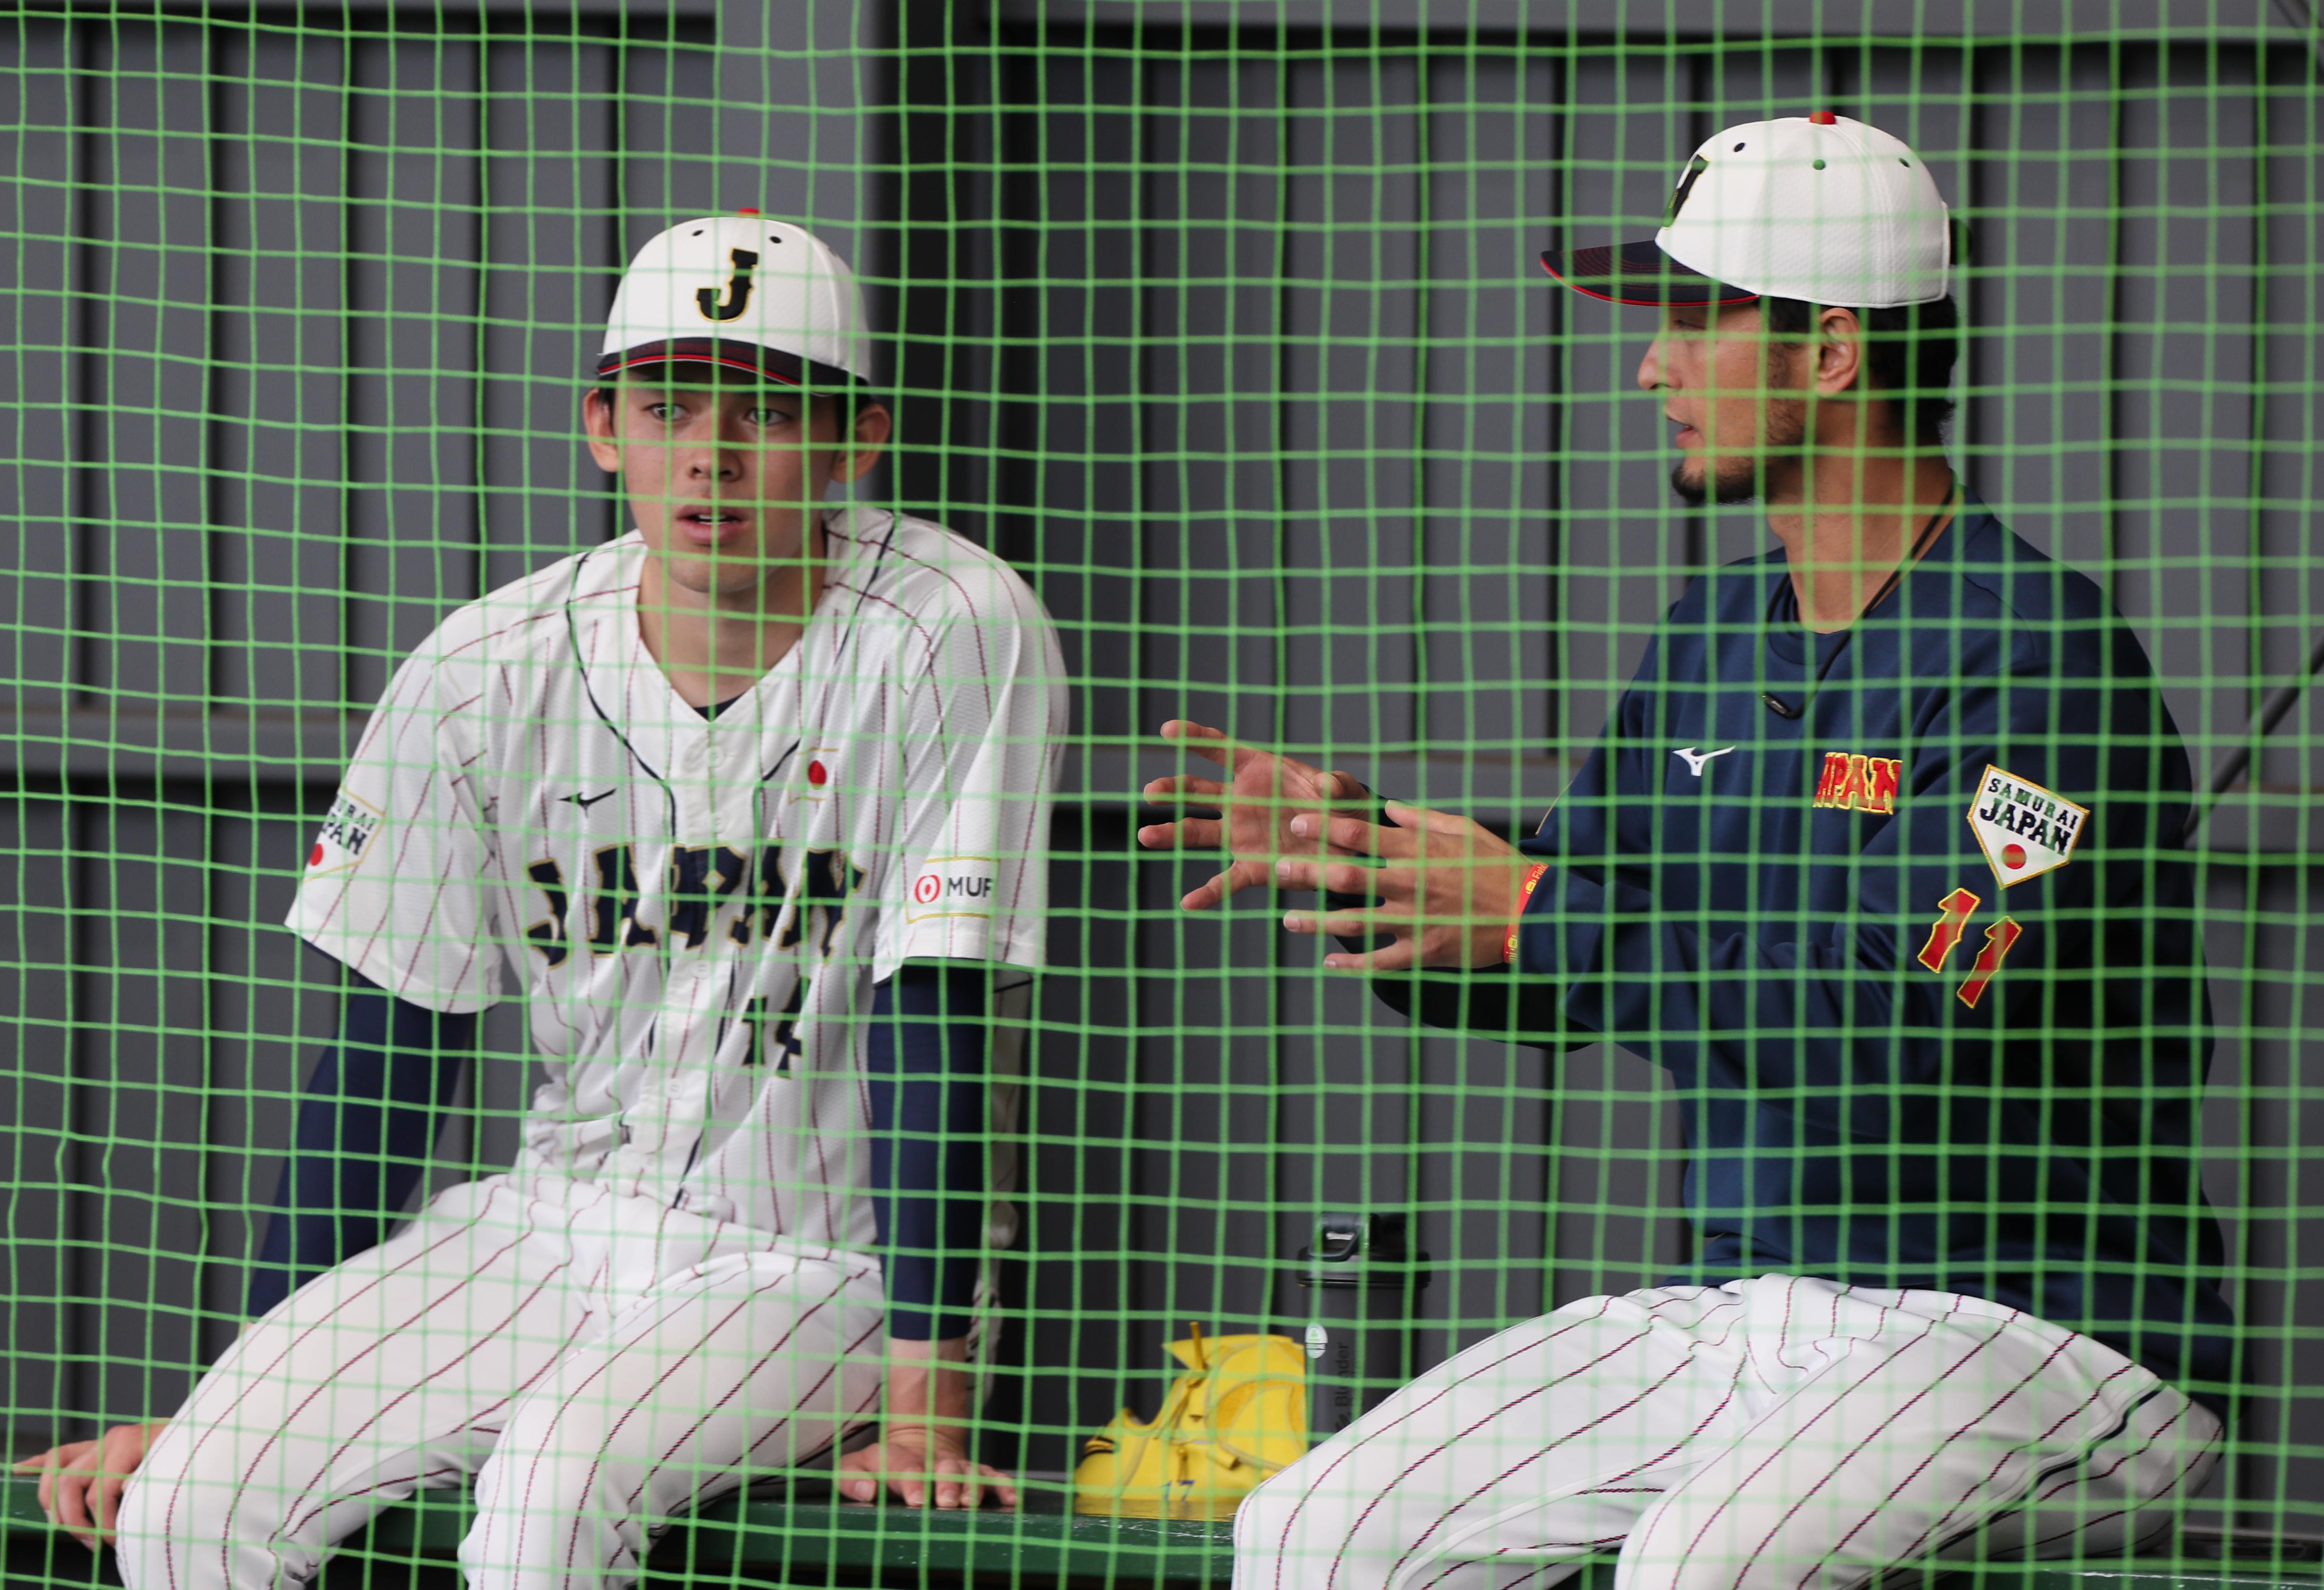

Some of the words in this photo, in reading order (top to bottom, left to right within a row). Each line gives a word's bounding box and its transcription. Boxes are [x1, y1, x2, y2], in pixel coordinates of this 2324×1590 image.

[695, 247, 759, 323] J
[1980, 797, 2072, 856] JAPAN
[1988, 778, 2078, 830] SAMURAI
[946, 876, 995, 898] MUF
[1917, 887, 2023, 1009] 11
